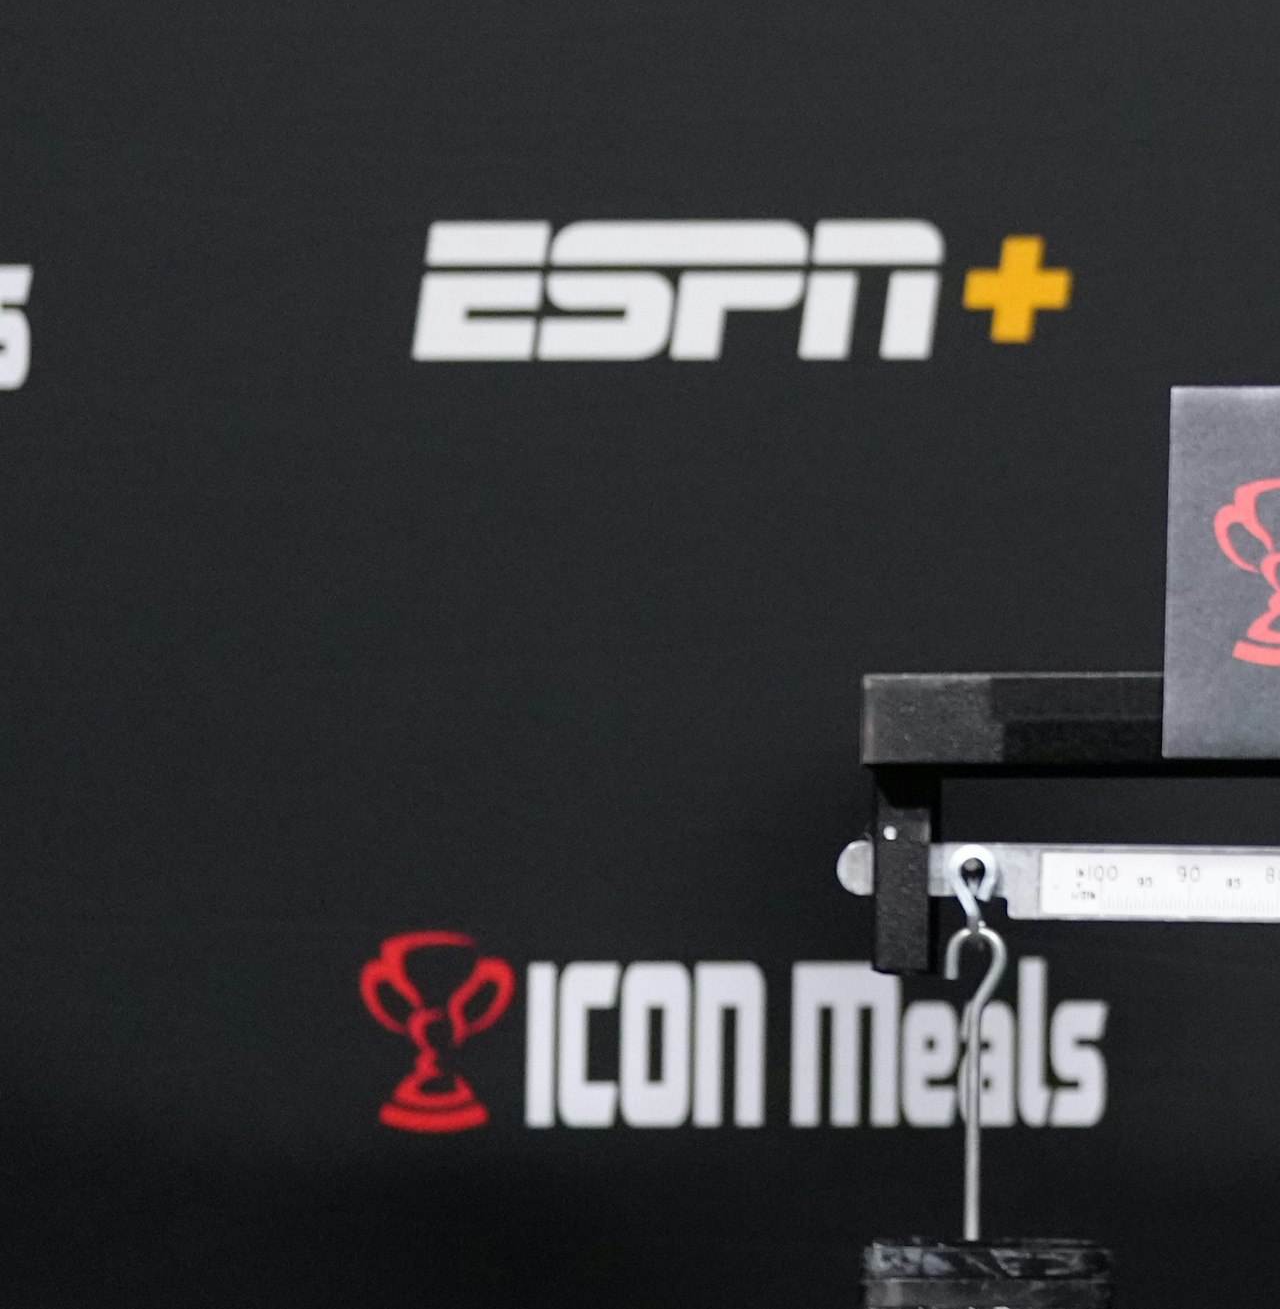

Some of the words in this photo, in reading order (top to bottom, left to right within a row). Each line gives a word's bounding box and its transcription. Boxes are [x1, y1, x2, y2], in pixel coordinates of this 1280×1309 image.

[1087, 865, 1118, 882] 100
[1177, 865, 1200, 882] 90
[524, 960, 767, 1129] ICON
[790, 957, 1107, 1129] Meals
